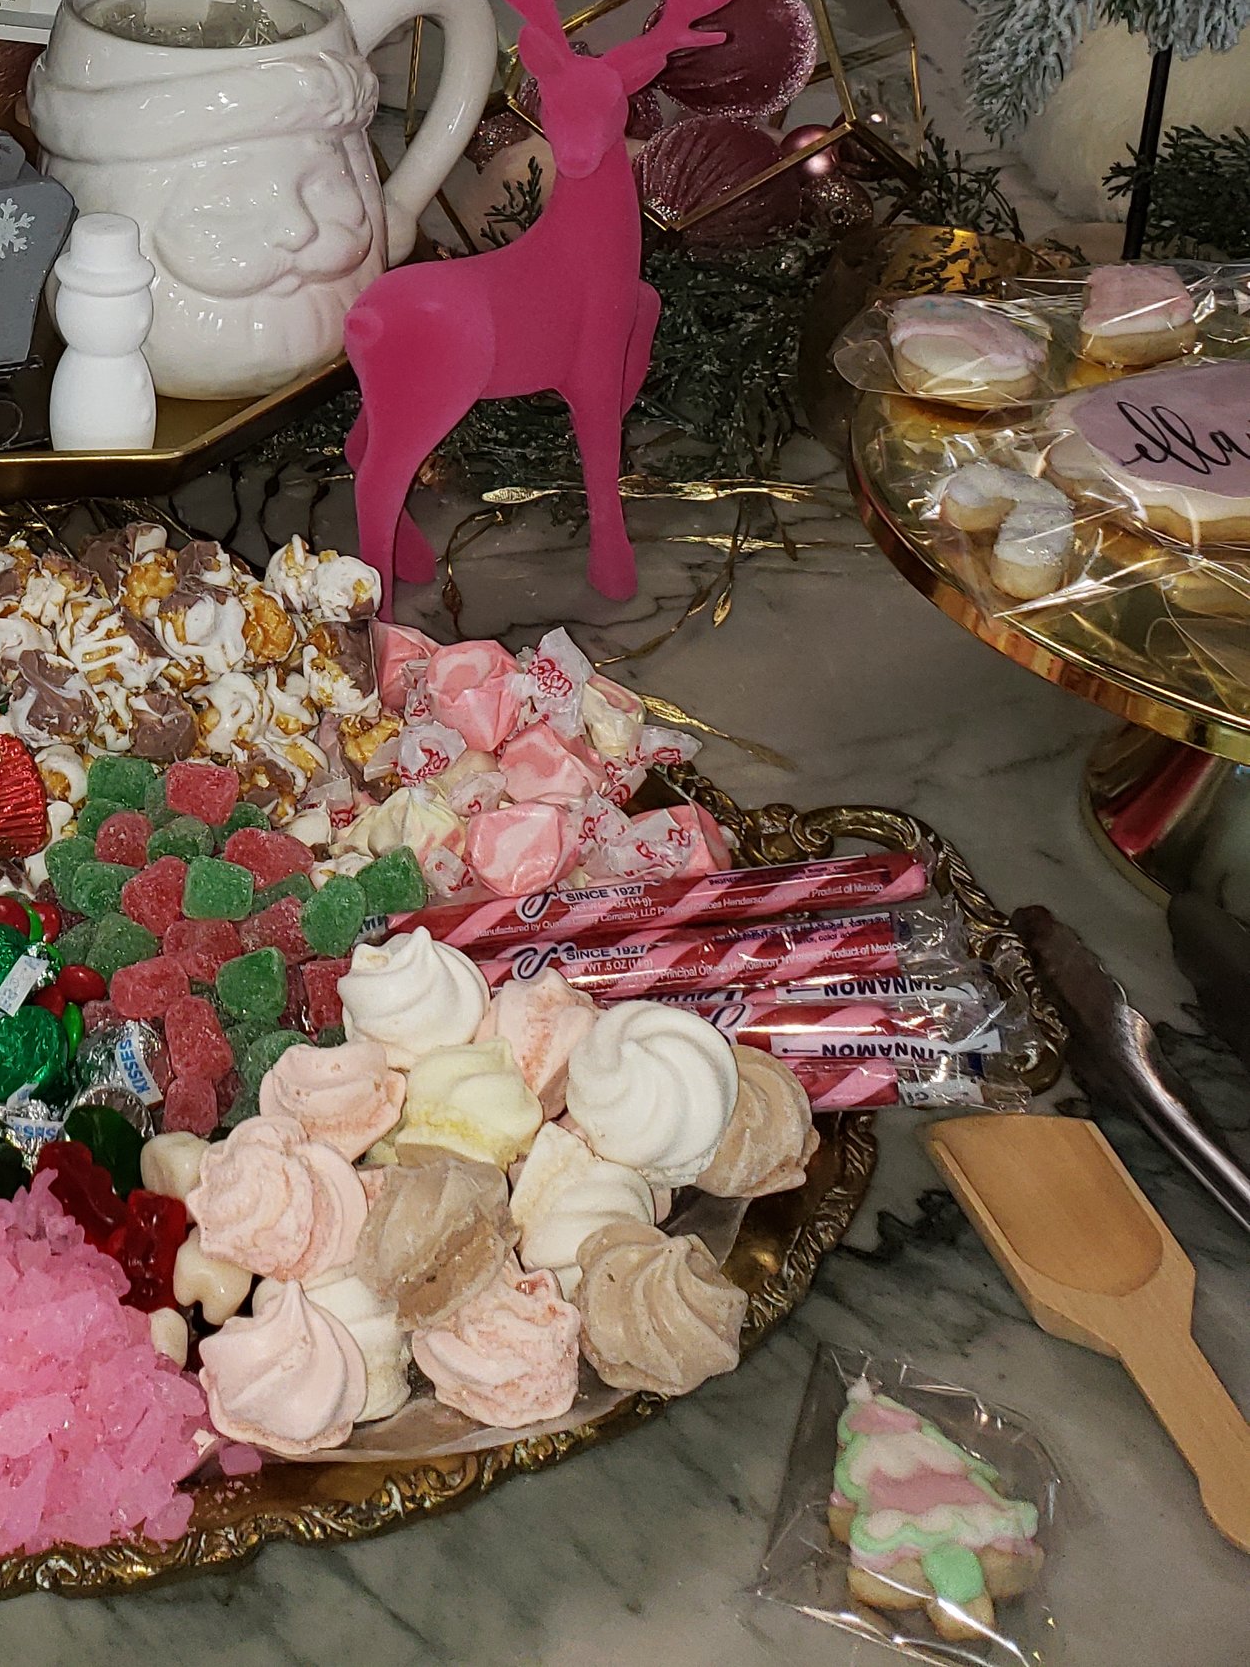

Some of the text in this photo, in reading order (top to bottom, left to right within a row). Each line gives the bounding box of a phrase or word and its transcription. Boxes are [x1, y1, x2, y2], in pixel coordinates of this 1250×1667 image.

[565, 885, 642, 902] SINCE 1927
[854, 881, 884, 893] Mexico
[566, 944, 646, 961] SINCE 1927
[661, 965, 697, 979] Principal
[826, 946, 858, 960] Product
[119, 1038, 151, 1094] KISSES
